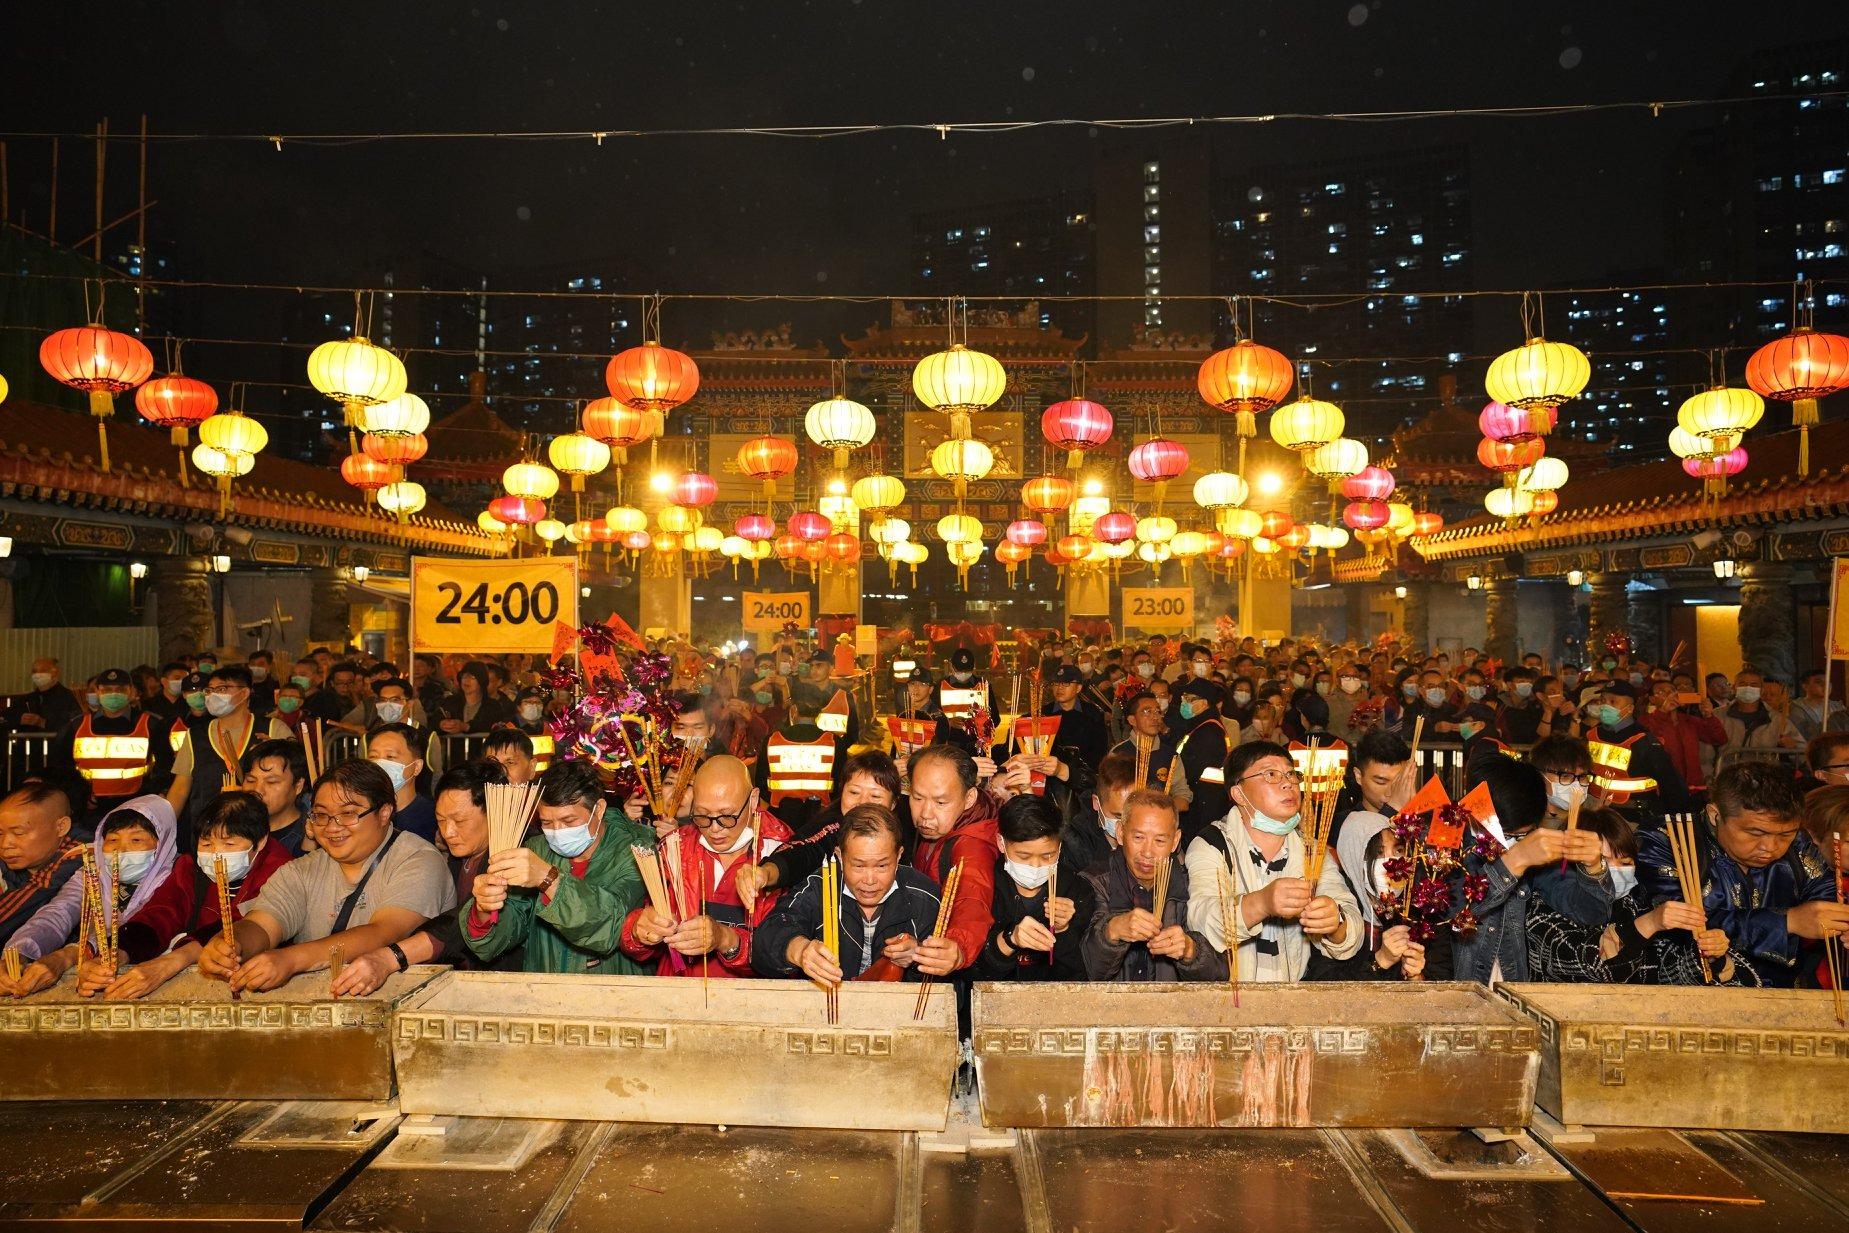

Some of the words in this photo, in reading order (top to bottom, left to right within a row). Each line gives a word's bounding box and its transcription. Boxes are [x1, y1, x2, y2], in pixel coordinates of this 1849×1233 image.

[436, 581, 559, 625] 24:00
[753, 602, 803, 619] 24:00
[1133, 597, 1184, 615] 23:00
